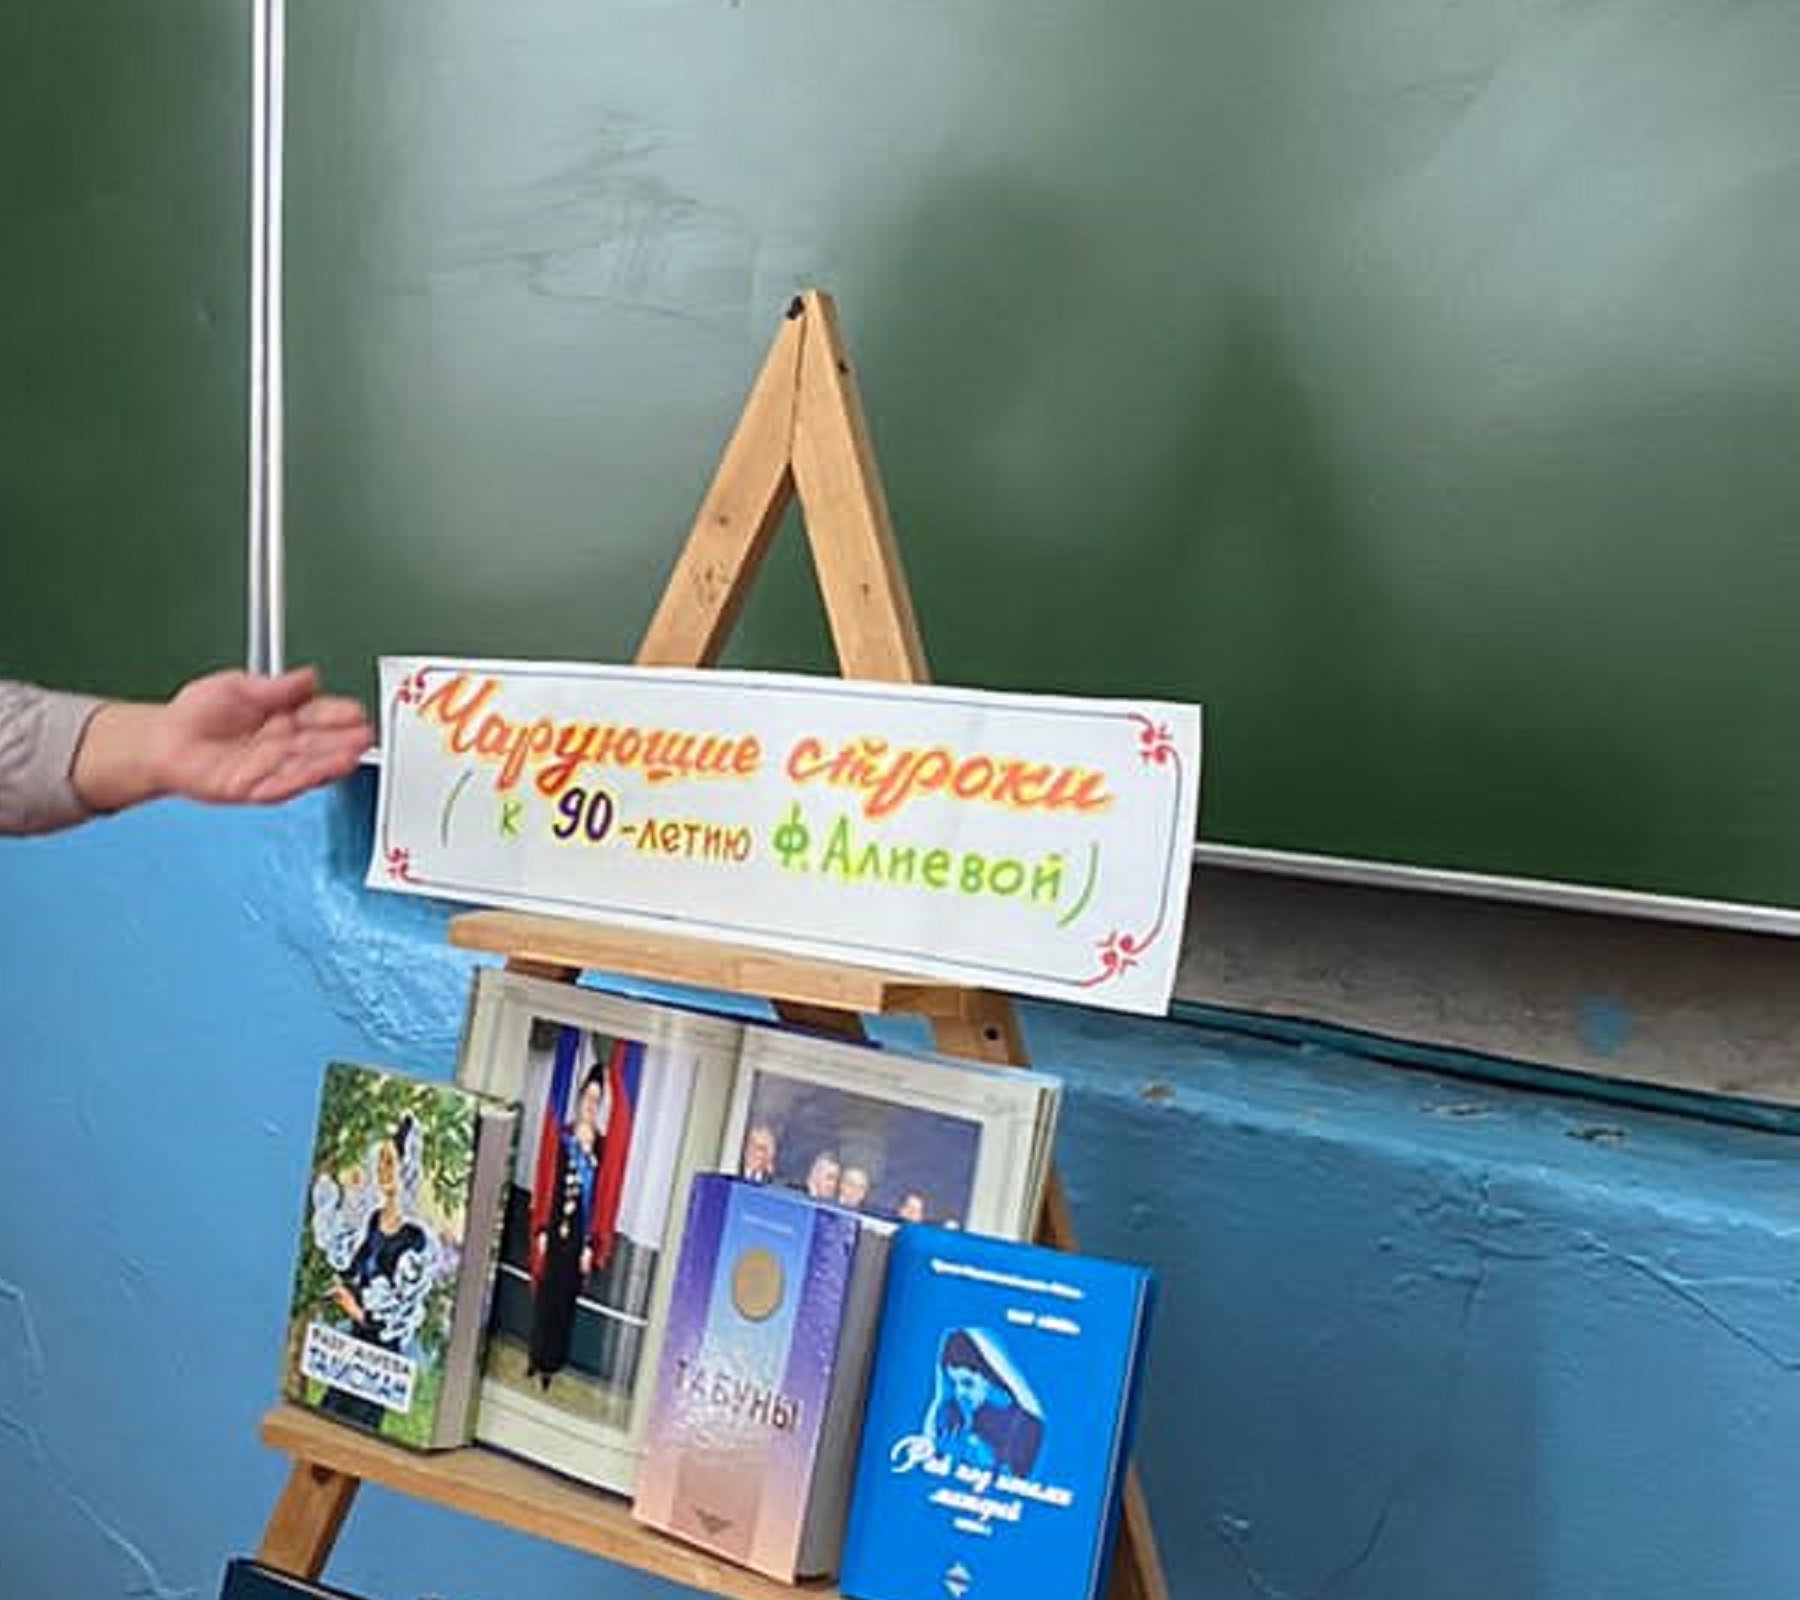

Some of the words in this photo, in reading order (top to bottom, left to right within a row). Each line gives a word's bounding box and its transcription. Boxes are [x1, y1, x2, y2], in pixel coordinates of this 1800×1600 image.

[417, 672, 760, 794] Чарующие
[786, 736, 1114, 821] строки
[674, 1357, 800, 1434] ТАБУНЫ
